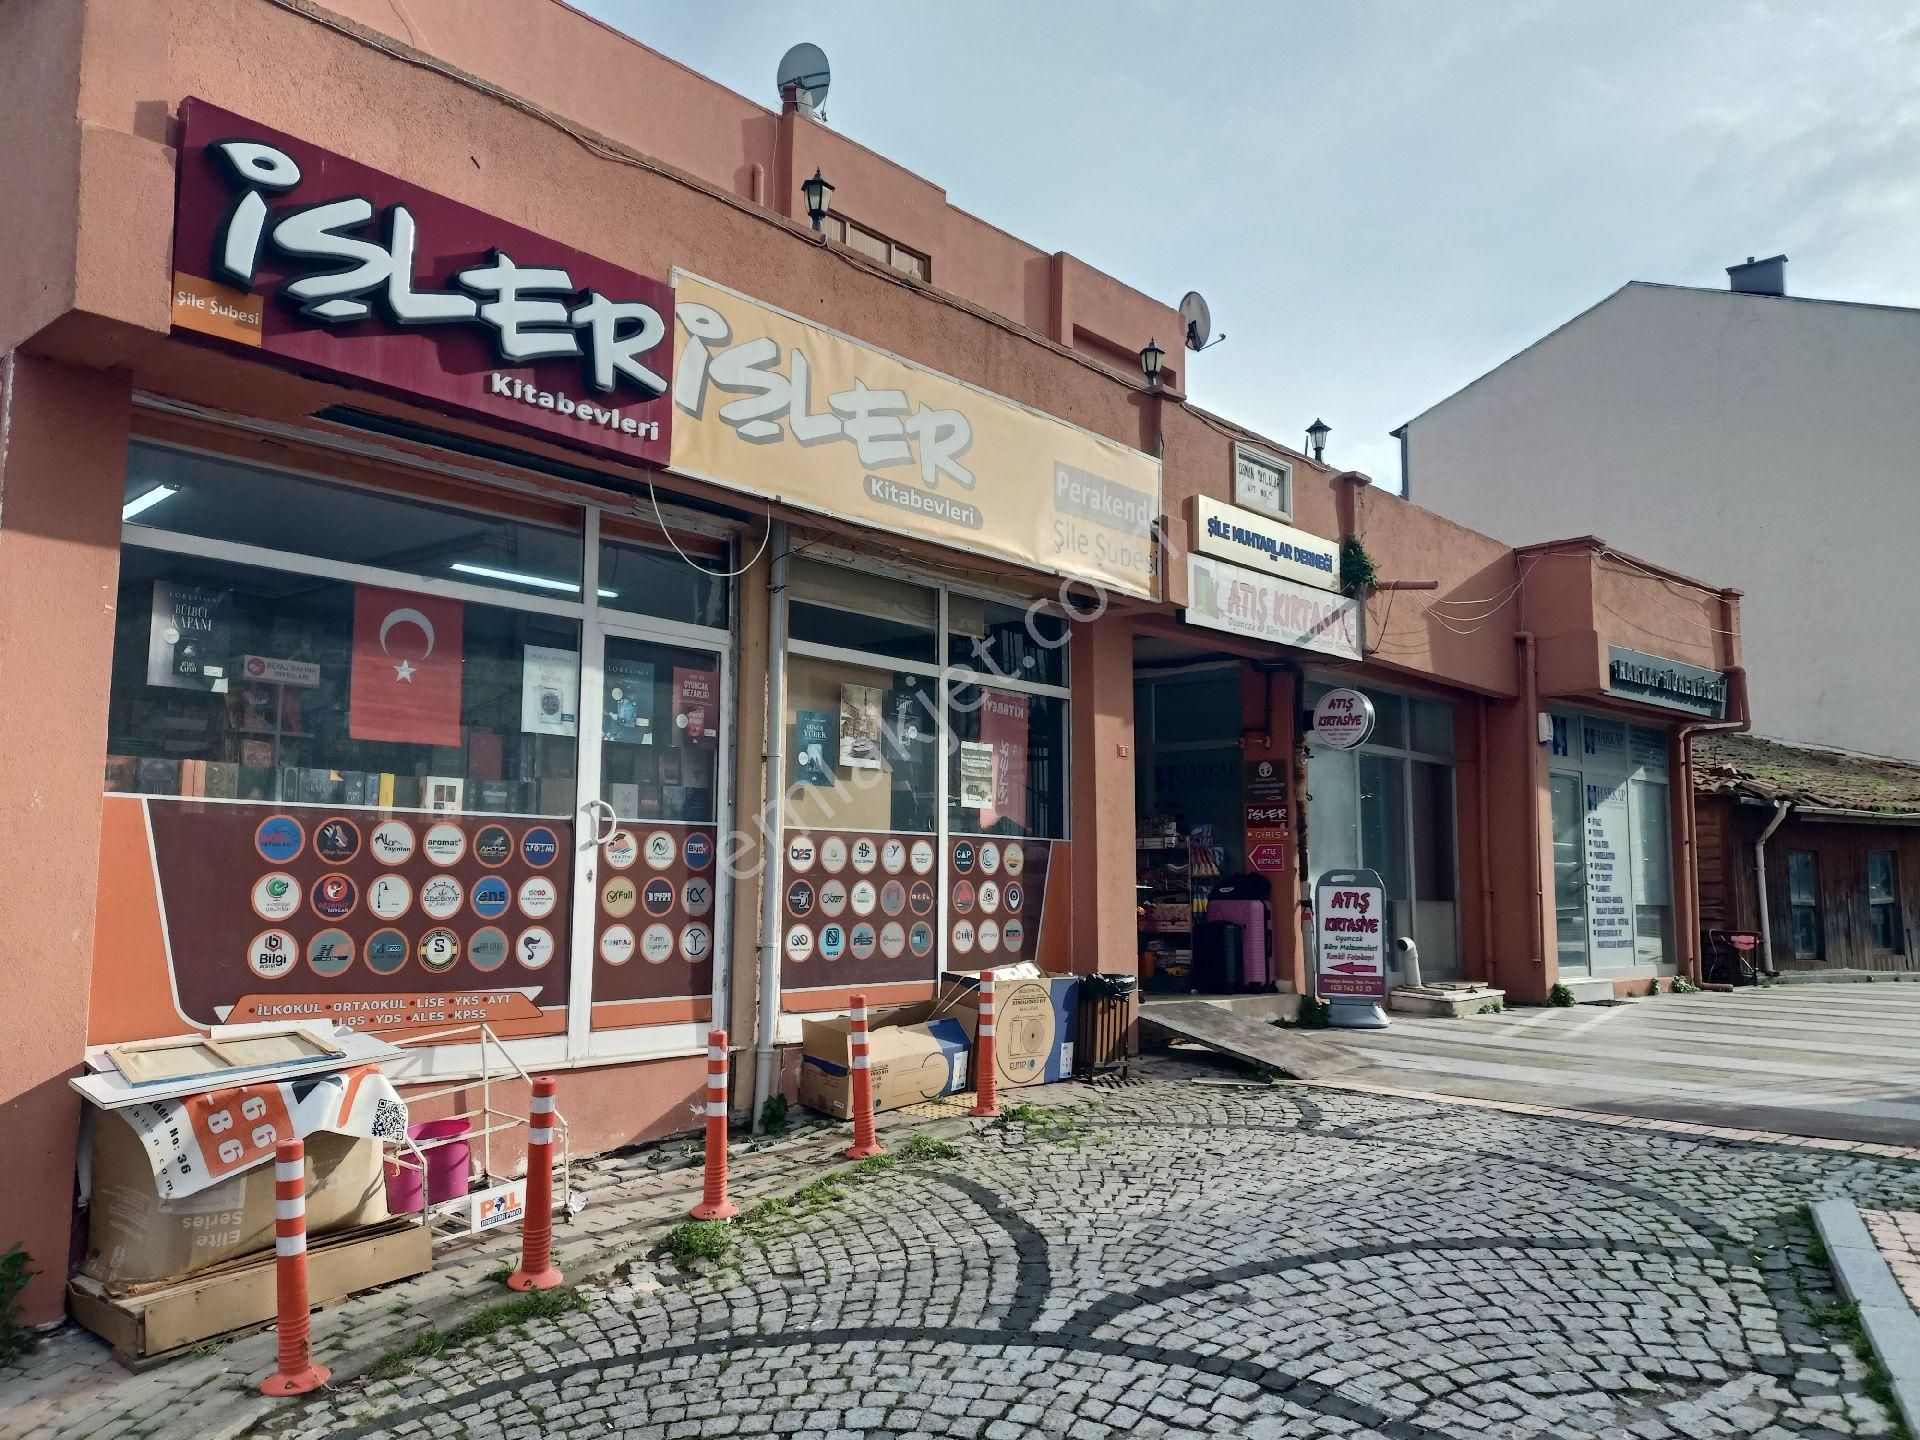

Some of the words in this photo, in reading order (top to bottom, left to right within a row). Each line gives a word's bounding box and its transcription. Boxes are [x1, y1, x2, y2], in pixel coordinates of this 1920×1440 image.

[177, 290, 206, 310] Şile
[209, 299, 260, 327] Şubesi
[490, 371, 661, 441] Kitabevleri
[870, 477, 976, 526] Kitabevleri
[1054, 518, 1089, 554] Şile
[1096, 533, 1158, 576] Şubesi
[1207, 515, 1231, 541] ŞİLE
[1294, 549, 1333, 573] DERNEĞİ
[175, 603, 210, 618] BÜLBÜL
[1228, 579, 1268, 633] ATIŞ
[171, 614, 212, 631] KAPANI
[683, 681, 709, 691] OYUNCAK
[1328, 698, 1354, 712] ATIŞ
[1318, 713, 1363, 727] KIRTASİYE
[1262, 848, 1277, 857] ATIŞ
[618, 891, 633, 899] Full
[1331, 891, 1371, 914] ATIŞ
[1325, 916, 1379, 933] KIRTASİYE
[259, 953, 287, 966] Bilgi
[257, 1002, 322, 1016] İLKOKUL
[333, 1000, 407, 1012] ORTAOKUL
[416, 997, 445, 1008] LİSE
[455, 996, 479, 1006] YKS
[487, 994, 512, 1004] AYT
[339, 1016, 365, 1026] LGS
[375, 1014, 402, 1023] YDS
[411, 1012, 445, 1022] ALES
[454, 1009, 487, 1019] KPSS
[169, 1127, 182, 1151] No:
[177, 1154, 192, 1176] 36
[183, 1211, 243, 1229] Series
[196, 1229, 240, 1247] Elite
